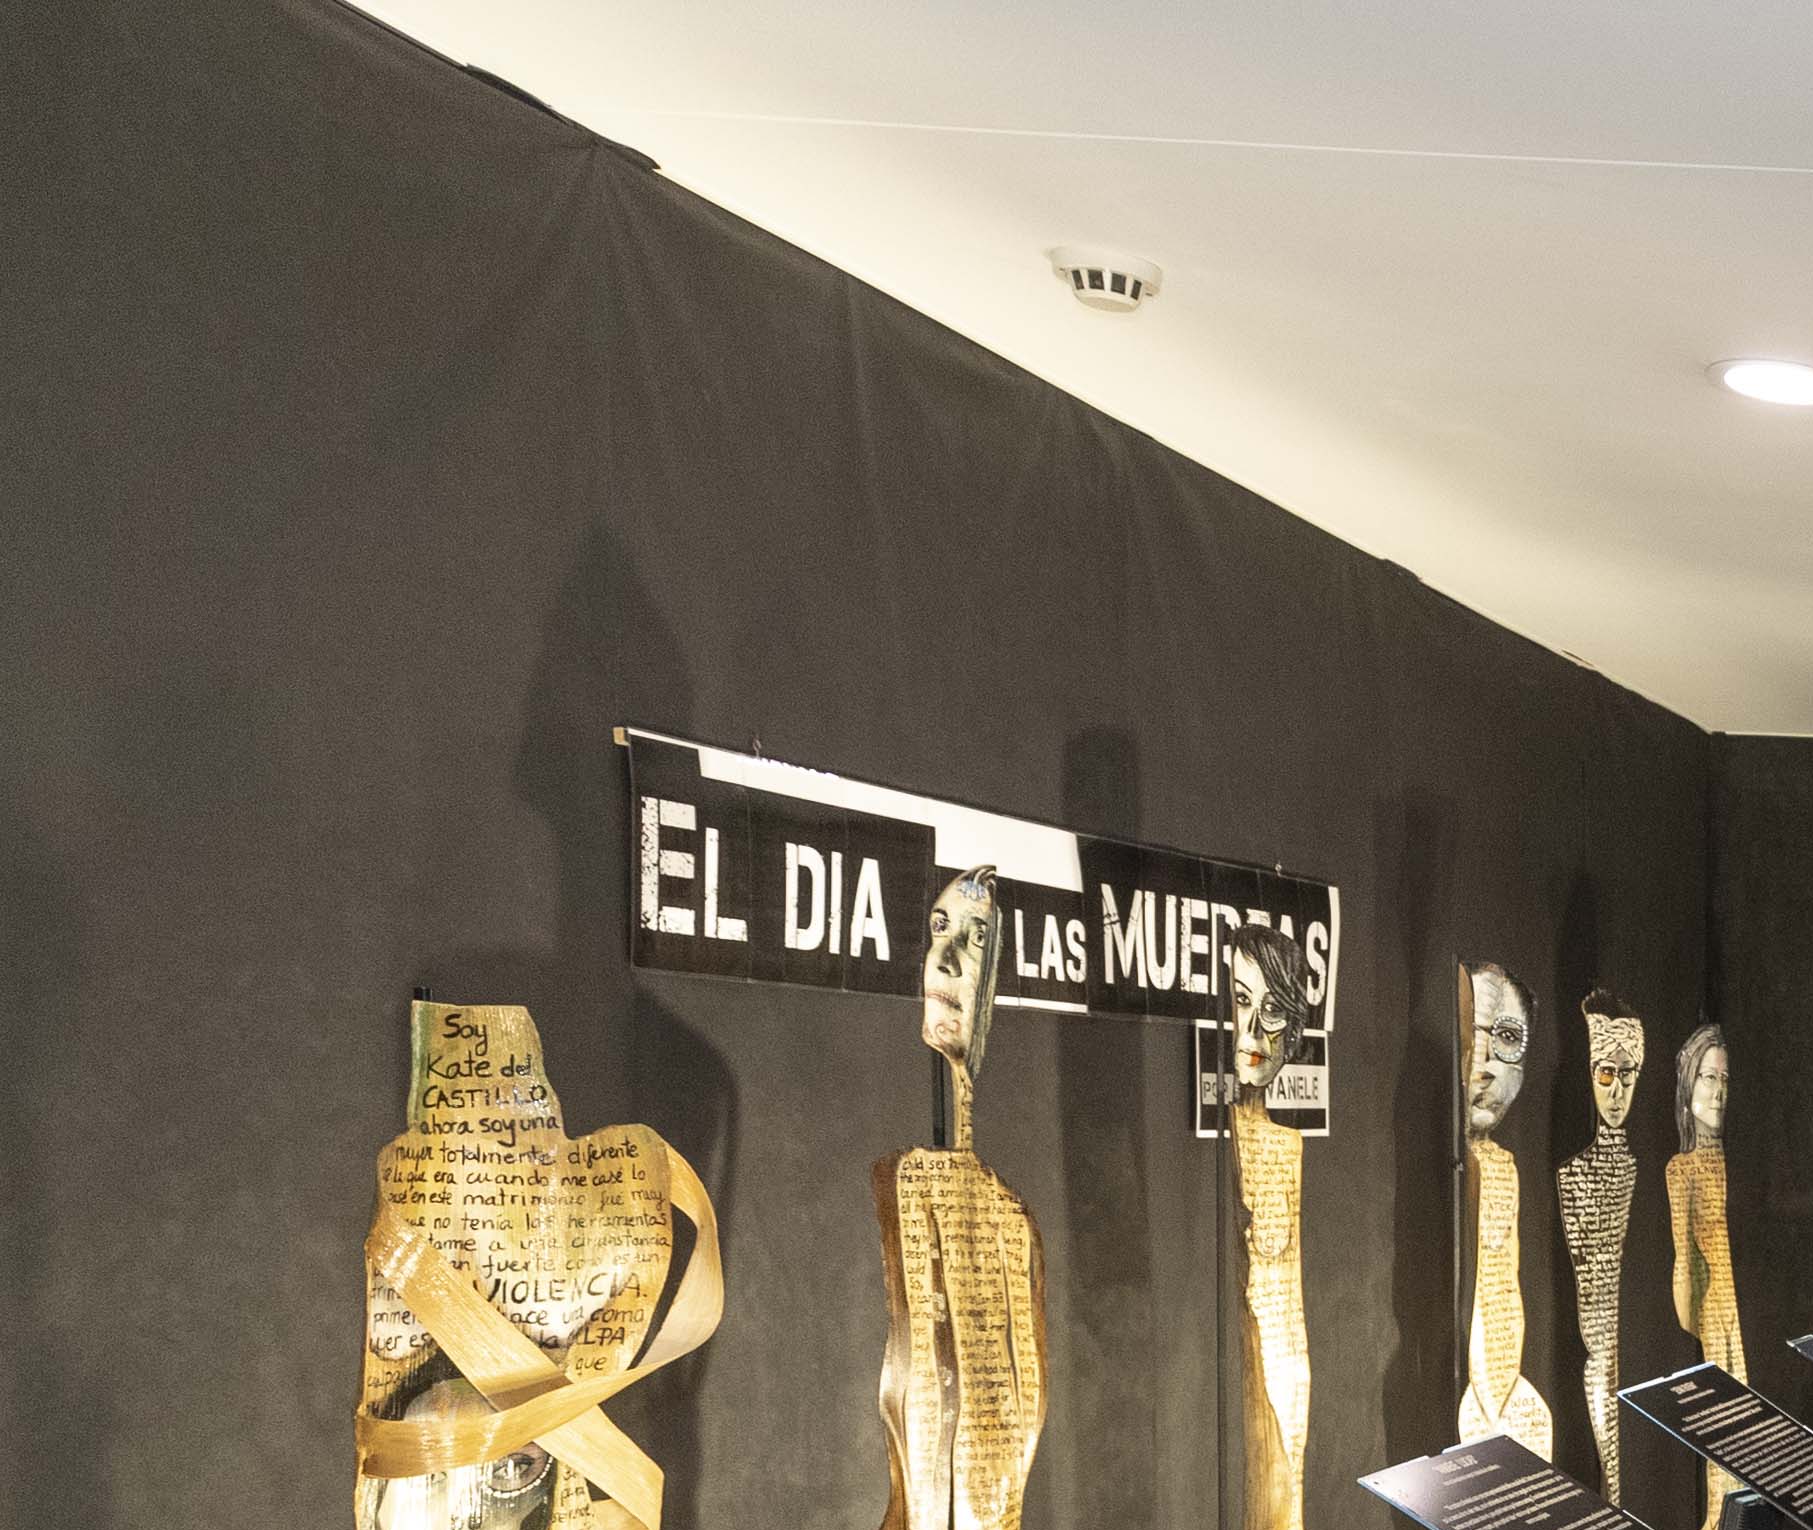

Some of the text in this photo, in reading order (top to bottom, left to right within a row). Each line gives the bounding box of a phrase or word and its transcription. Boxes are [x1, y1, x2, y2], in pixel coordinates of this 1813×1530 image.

[641, 796, 1329, 1005] EL DIA LAS MUERS
[442, 1013, 488, 1056] Soy
[426, 1051, 492, 1079] Kate
[421, 1114, 562, 1147] ahora soy una
[440, 1140, 556, 1165] totalmente
[568, 1136, 640, 1168] diferente
[434, 1172, 457, 1184] era
[466, 1170, 549, 1186] cuando
[561, 1175, 588, 1187] me
[434, 1216, 451, 1229] no
[461, 1212, 513, 1231] tenía
